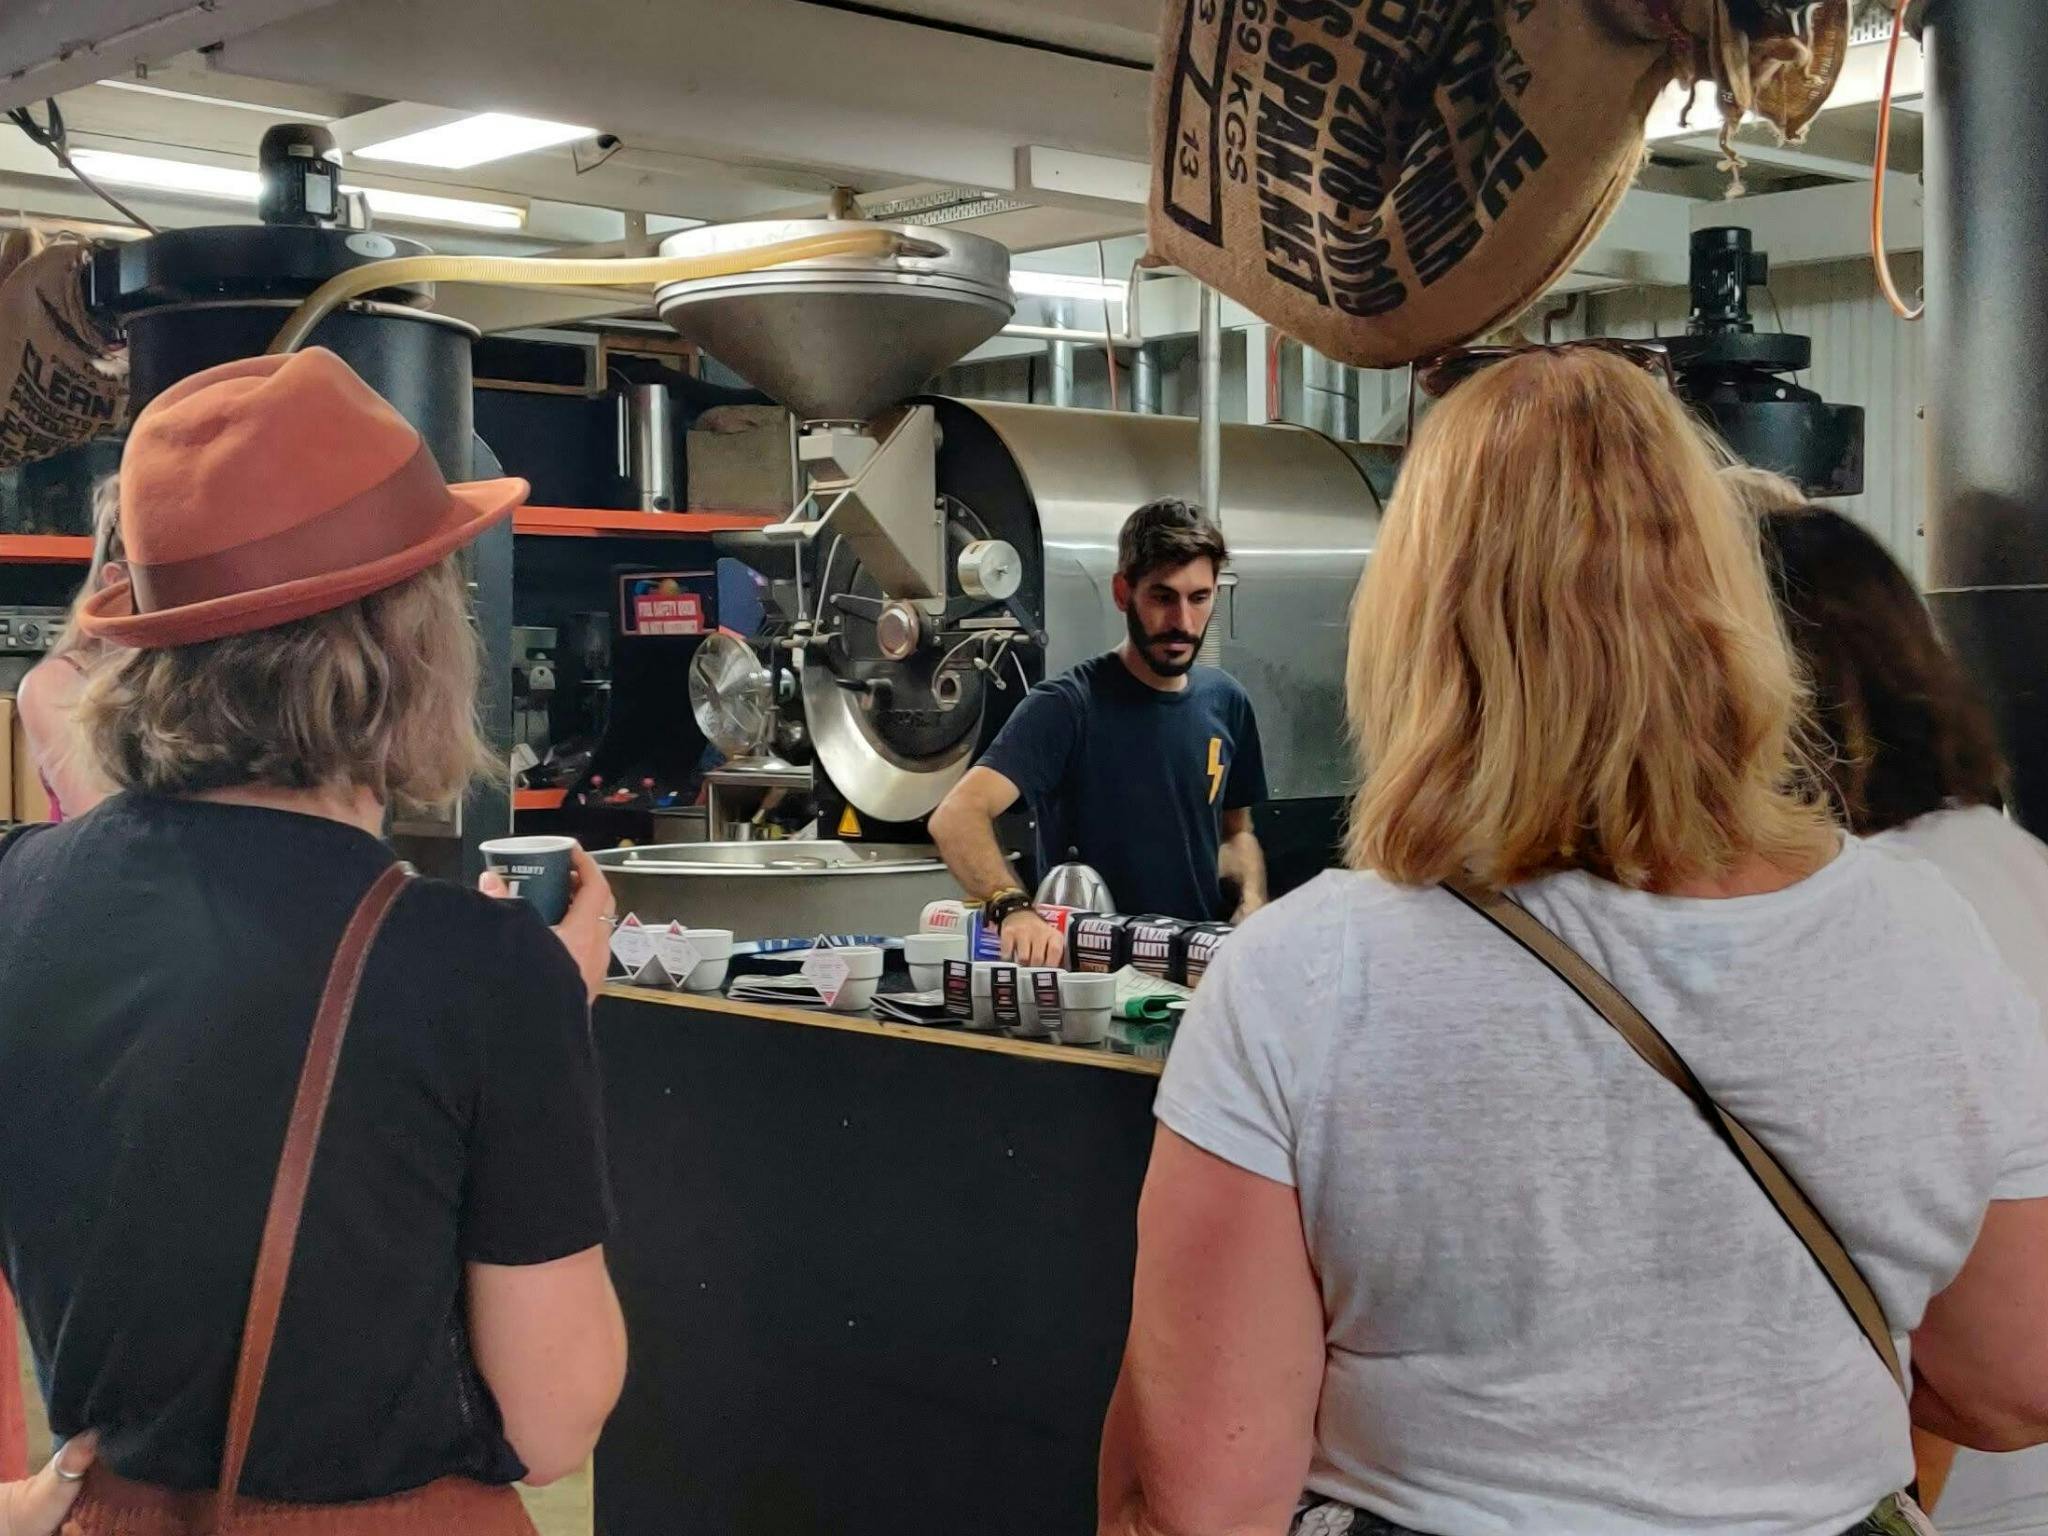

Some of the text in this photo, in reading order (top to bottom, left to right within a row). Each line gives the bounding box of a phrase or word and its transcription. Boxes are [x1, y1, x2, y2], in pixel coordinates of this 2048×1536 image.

[1177, 129, 1201, 180] 13
[1223, 72, 1251, 186] KGS
[1255, 0, 1354, 307] S.SPAN.NET
